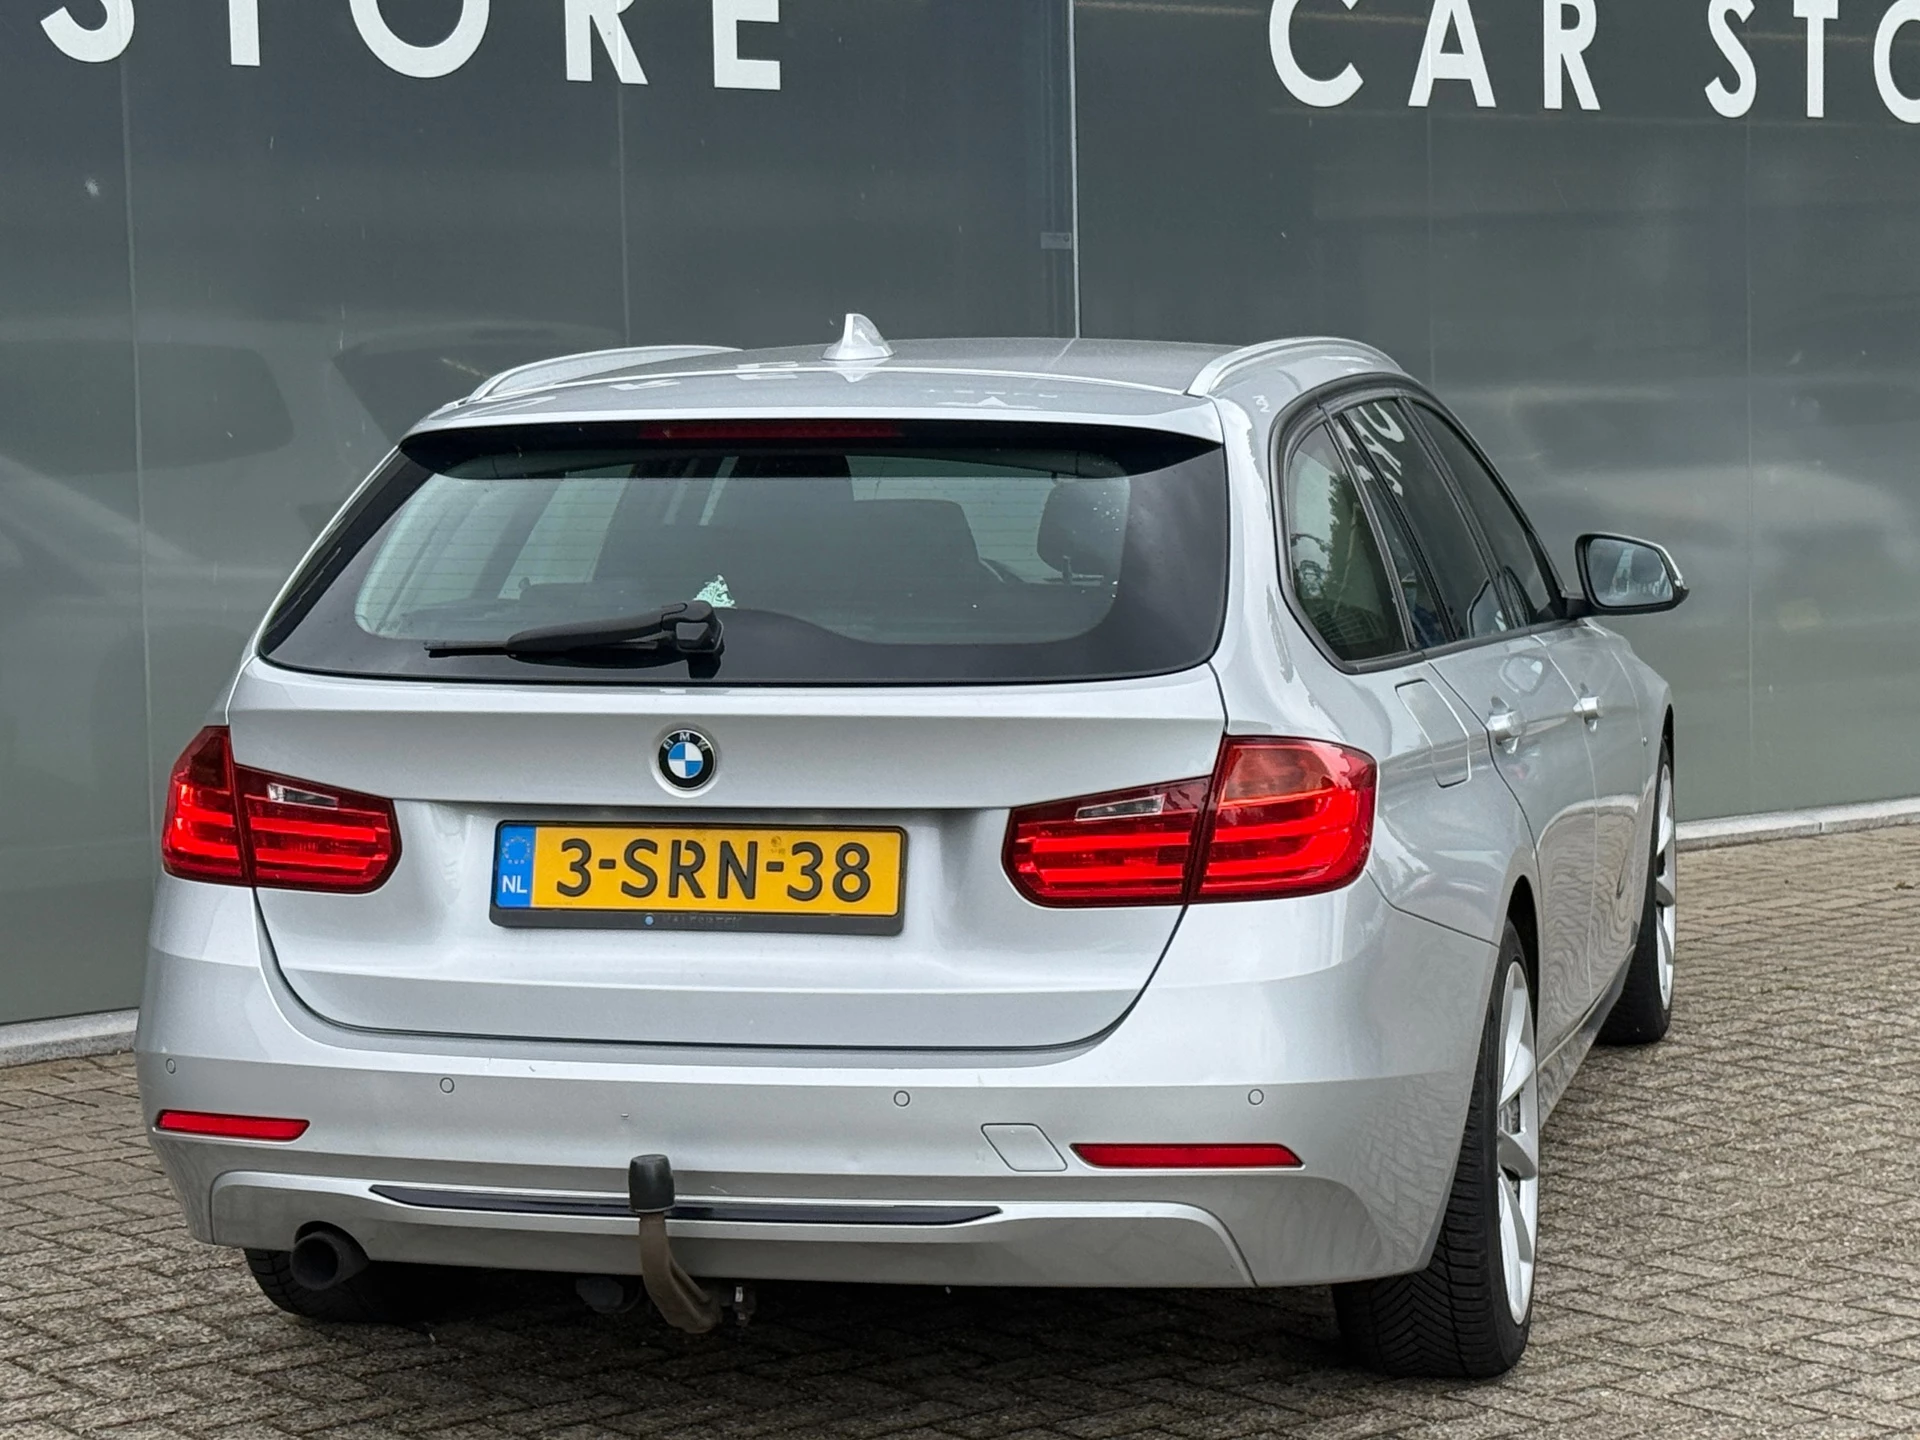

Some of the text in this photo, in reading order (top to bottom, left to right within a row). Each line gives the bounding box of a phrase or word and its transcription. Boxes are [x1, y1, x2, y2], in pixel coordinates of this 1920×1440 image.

[1269, 0, 1601, 111] CAR
[662, 732, 710, 752] BMW
[502, 838, 870, 902] NL 3-SRN-38
